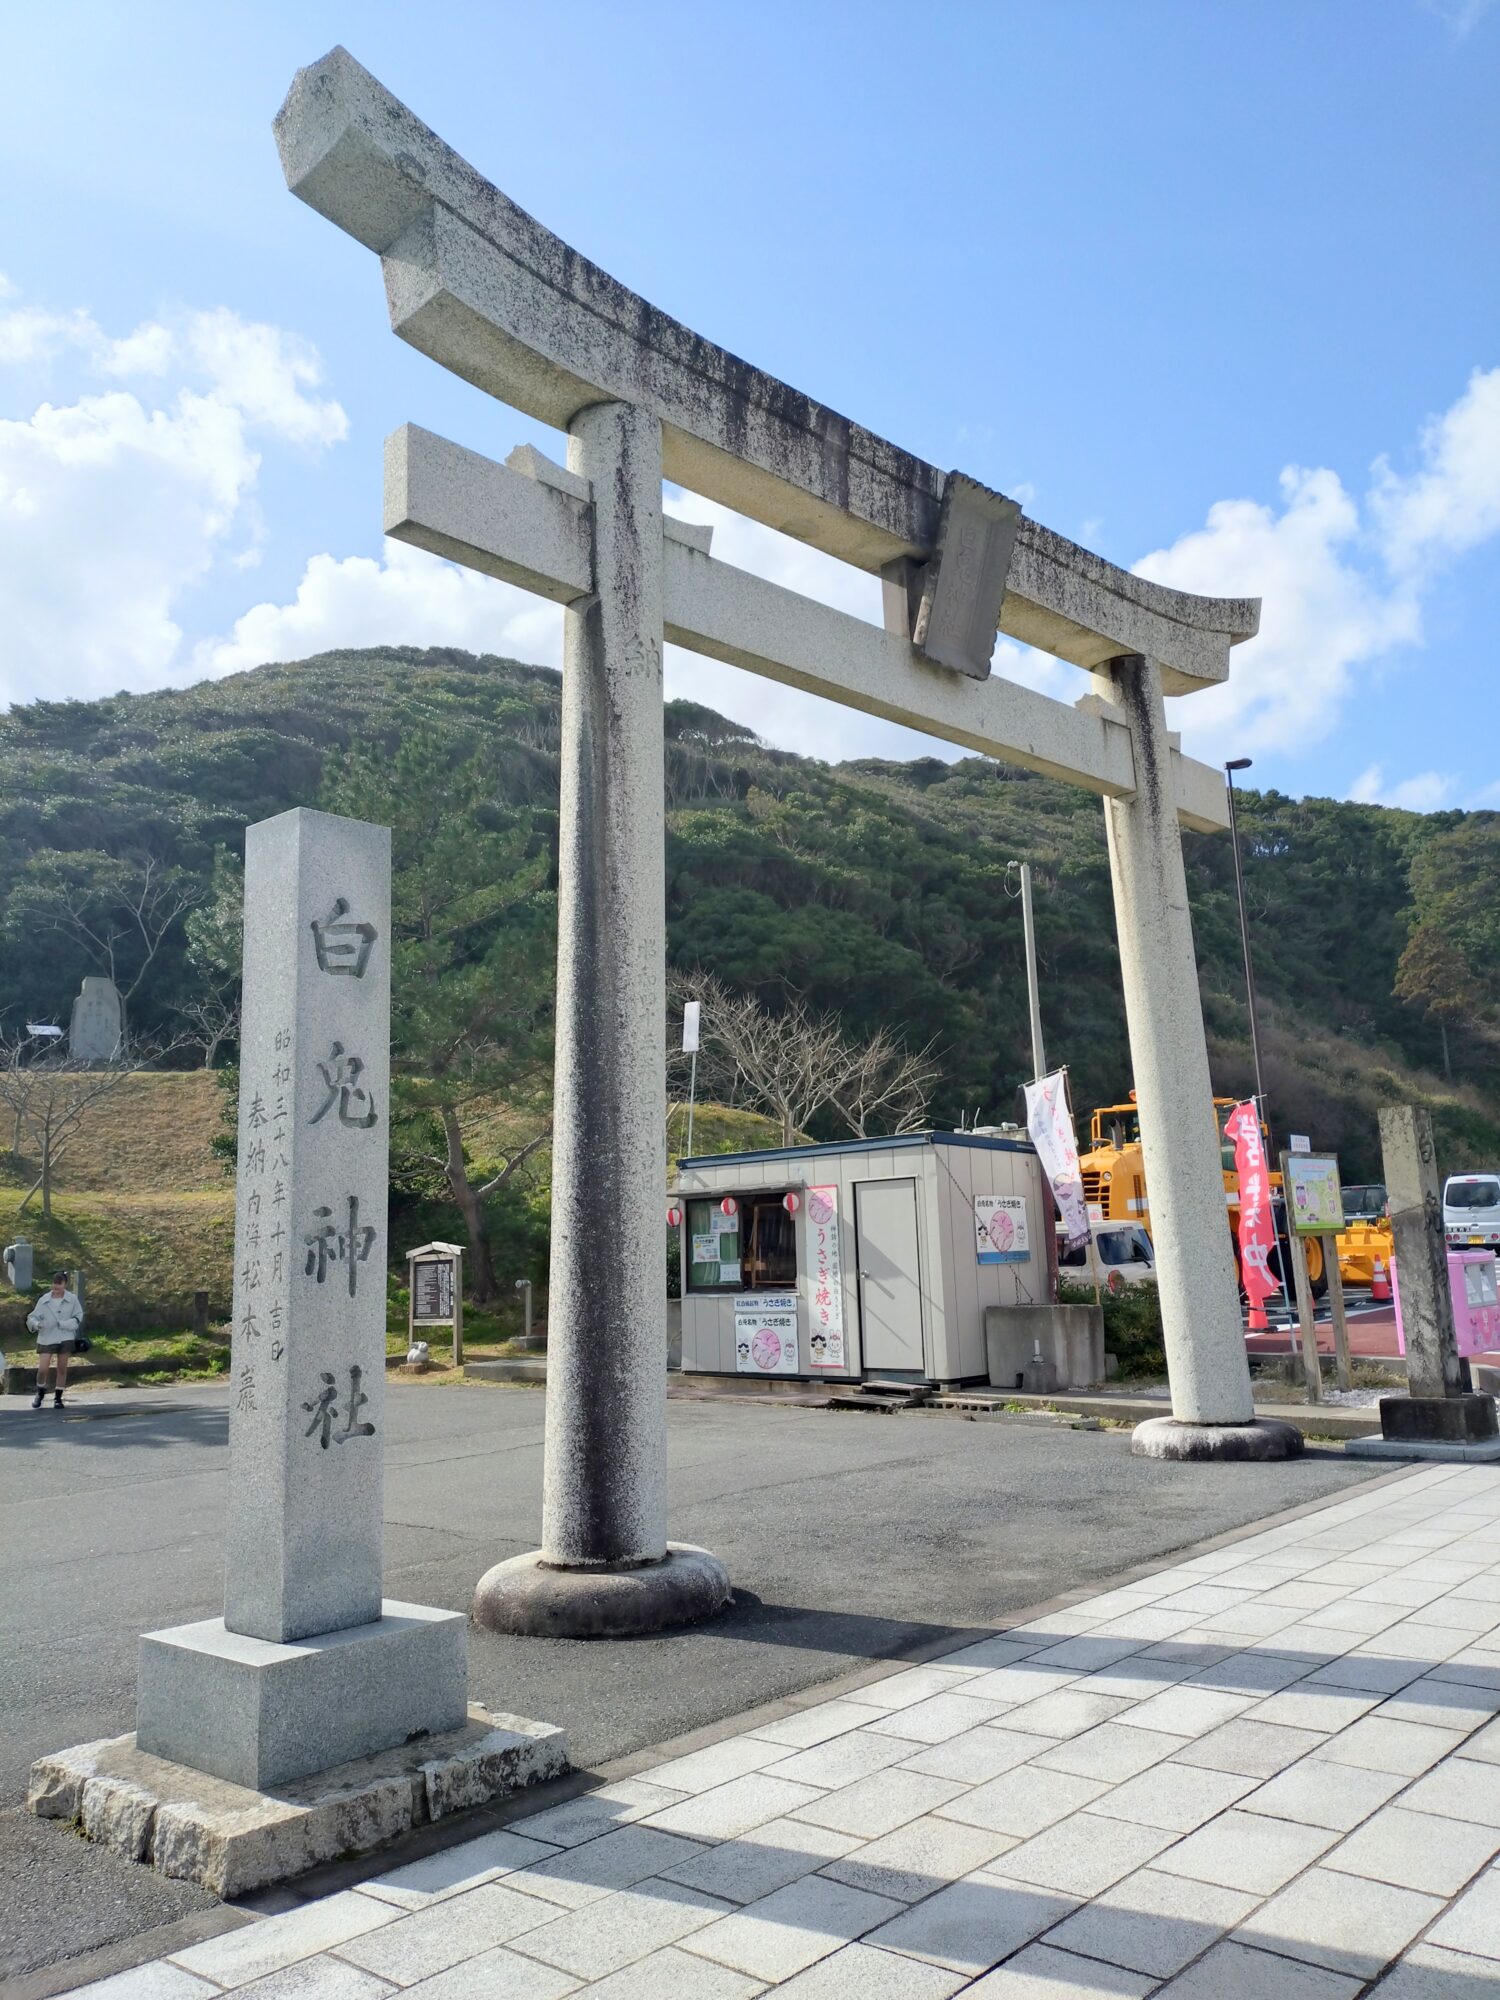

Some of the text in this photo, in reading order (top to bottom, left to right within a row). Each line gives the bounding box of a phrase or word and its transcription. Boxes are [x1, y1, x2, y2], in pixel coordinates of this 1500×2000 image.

[815, 1228, 832, 1326] うさぎ焼き
